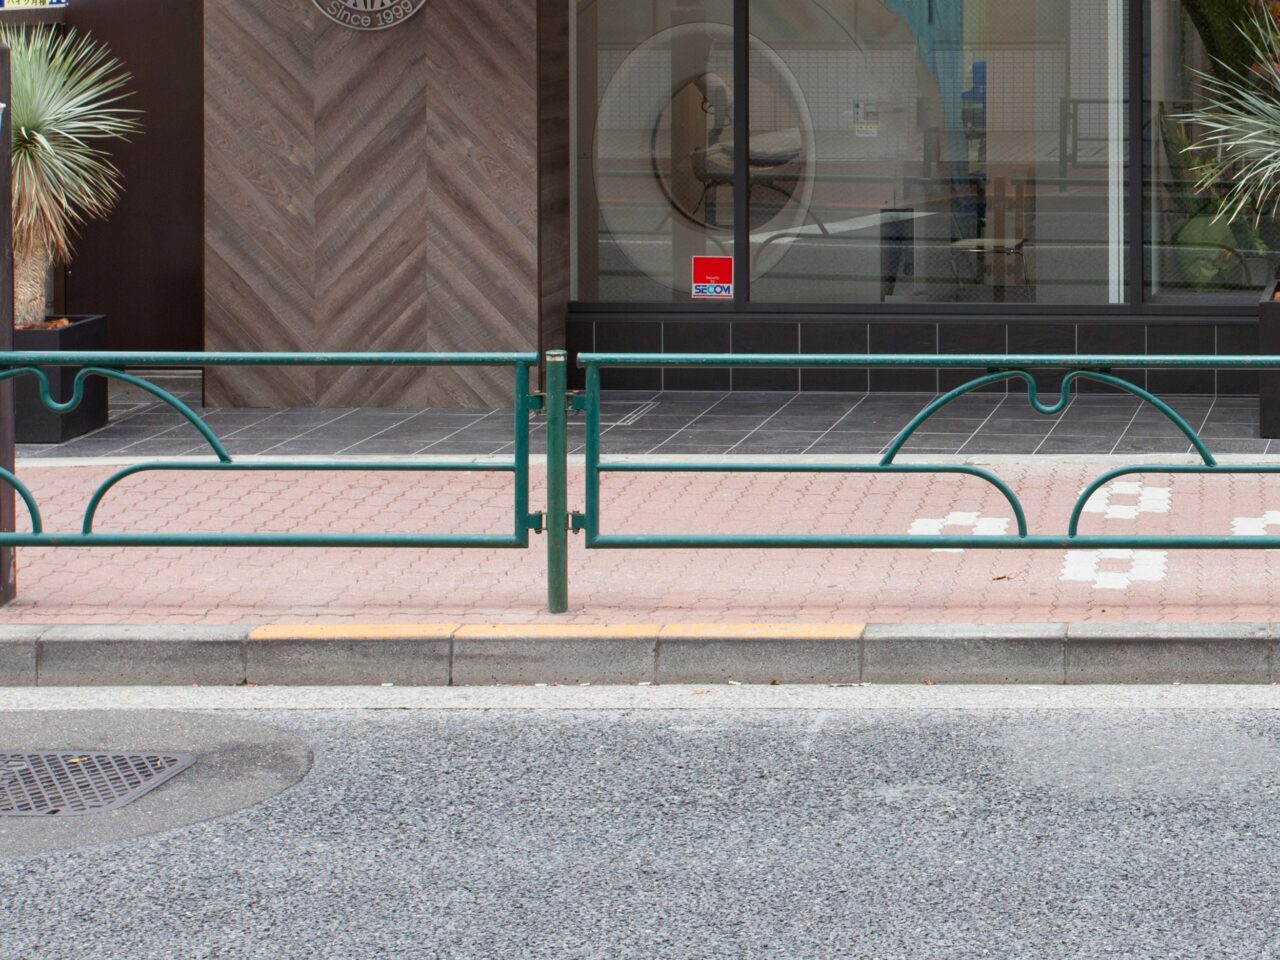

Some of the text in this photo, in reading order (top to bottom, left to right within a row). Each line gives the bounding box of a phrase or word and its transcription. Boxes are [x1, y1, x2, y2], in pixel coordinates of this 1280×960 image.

[327, 0, 413, 27] Since 1999
[694, 284, 731, 295] SECOM
